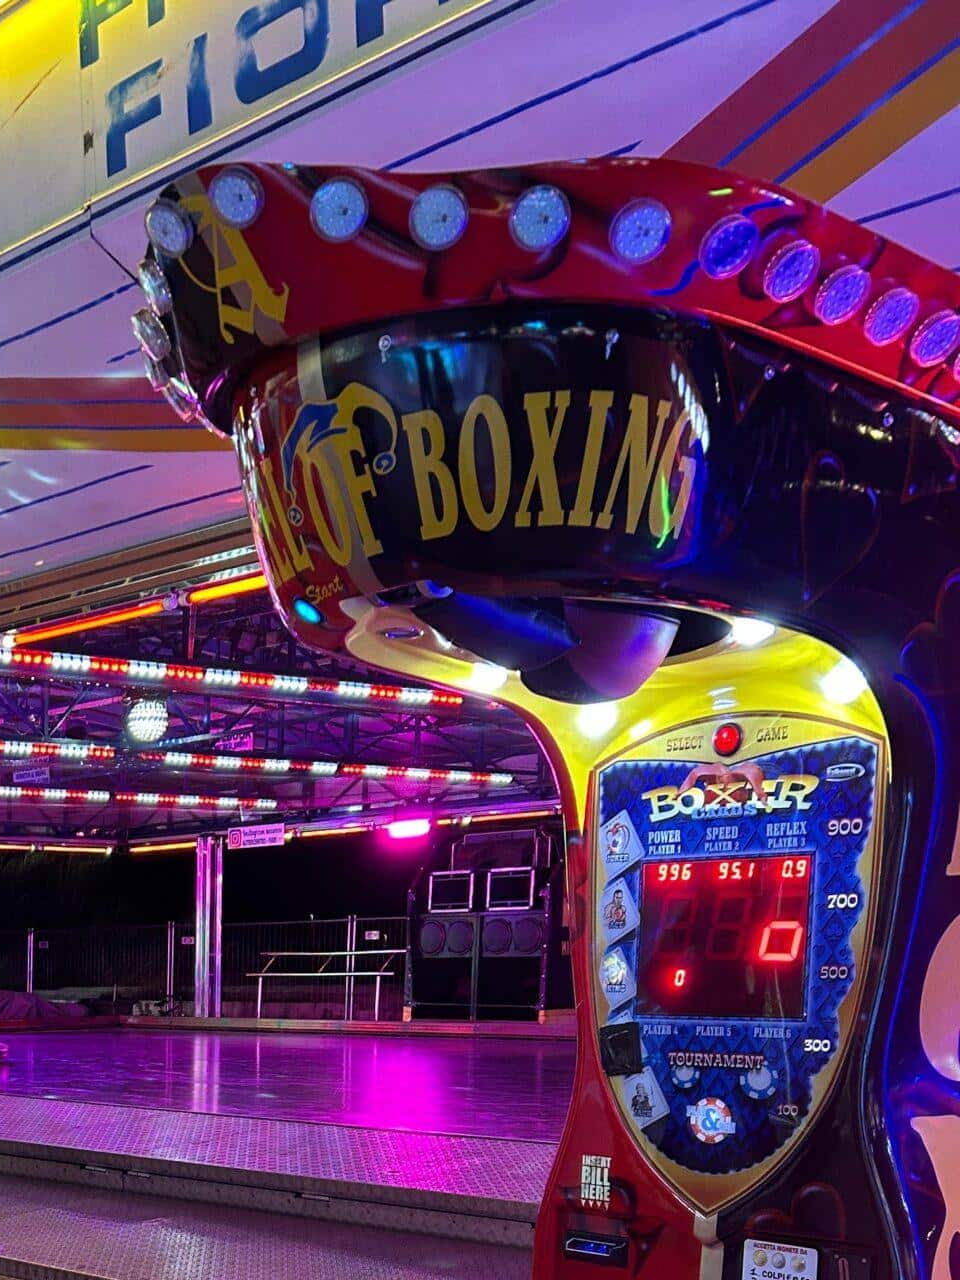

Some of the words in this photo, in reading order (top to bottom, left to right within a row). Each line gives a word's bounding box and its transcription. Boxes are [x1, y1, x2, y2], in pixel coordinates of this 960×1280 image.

[402, 388, 697, 542] BOXING
[665, 735, 705, 752] SELECT
[755, 725, 789, 742] GAME
[705, 826, 739, 840] SPEED
[766, 821, 807, 837] REFLEX
[827, 818, 864, 837] 900
[648, 829, 681, 844] POWER
[767, 838, 799, 849] PLAYER
[648, 845, 676, 855] PLAYER
[704, 841, 733, 852] PLAYER
[657, 863, 693, 881] 996
[827, 893, 858, 909] 700
[758, 920, 804, 962] 0
[819, 965, 848, 980] 500
[642, 1024, 672, 1036] PLAYER
[695, 1026, 725, 1037] PLAYER
[753, 1027, 784, 1038] PLAYER
[803, 1038, 831, 1052] 300
[667, 1052, 765, 1070] TOURNAMENT
[777, 1103, 799, 1116] 100
[582, 1154, 611, 1169] INSERT
[581, 1165, 611, 1187] BILL
[580, 1183, 610, 1202] HERE
